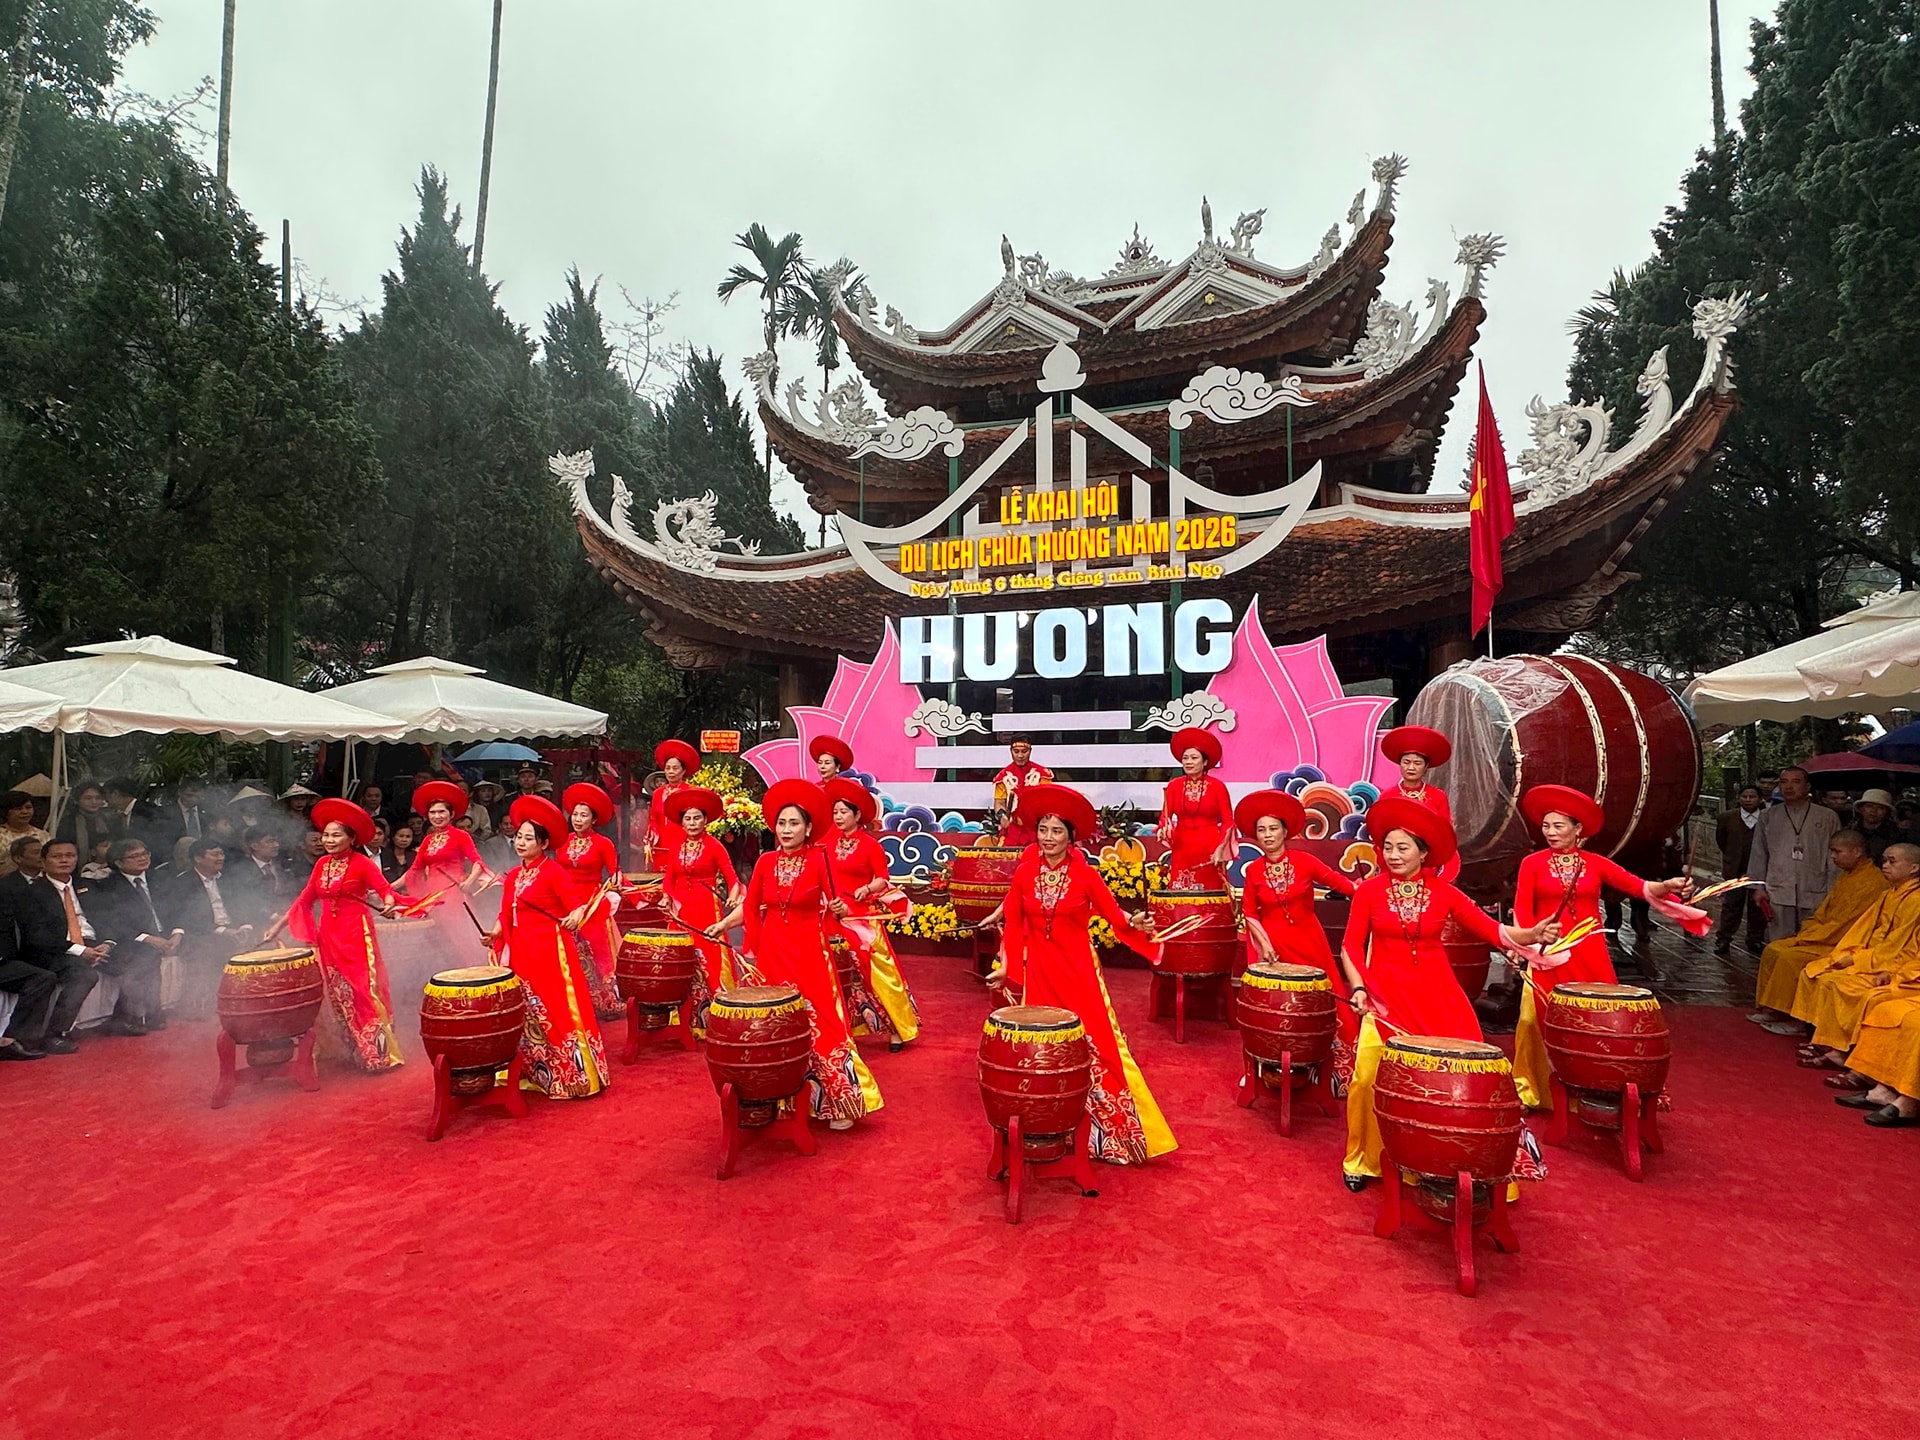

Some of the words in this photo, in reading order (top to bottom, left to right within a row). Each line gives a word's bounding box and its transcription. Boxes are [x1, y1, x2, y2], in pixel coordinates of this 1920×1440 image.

[1000, 486, 1023, 525] LỄ
[1027, 489, 1077, 523] KHAI
[1082, 480, 1118, 522] HỘI
[900, 543, 926, 573] DU
[932, 539, 973, 575] LỊCH
[978, 530, 1033, 567] CHÙA
[1037, 527, 1110, 562] HƯƠNG
[1116, 517, 1170, 556] NĂM
[1175, 515, 1237, 551] 2026
[910, 581, 947, 598] Ngày
[995, 576, 1007, 591] 6
[1010, 573, 1054, 590] tháng
[1057, 571, 1104, 588] Giêng
[1107, 569, 1143, 584] năm
[1147, 564, 1187, 581] Bính
[1188, 561, 1224, 580] Ngọ
[900, 598, 1233, 683] HƯƠNG
